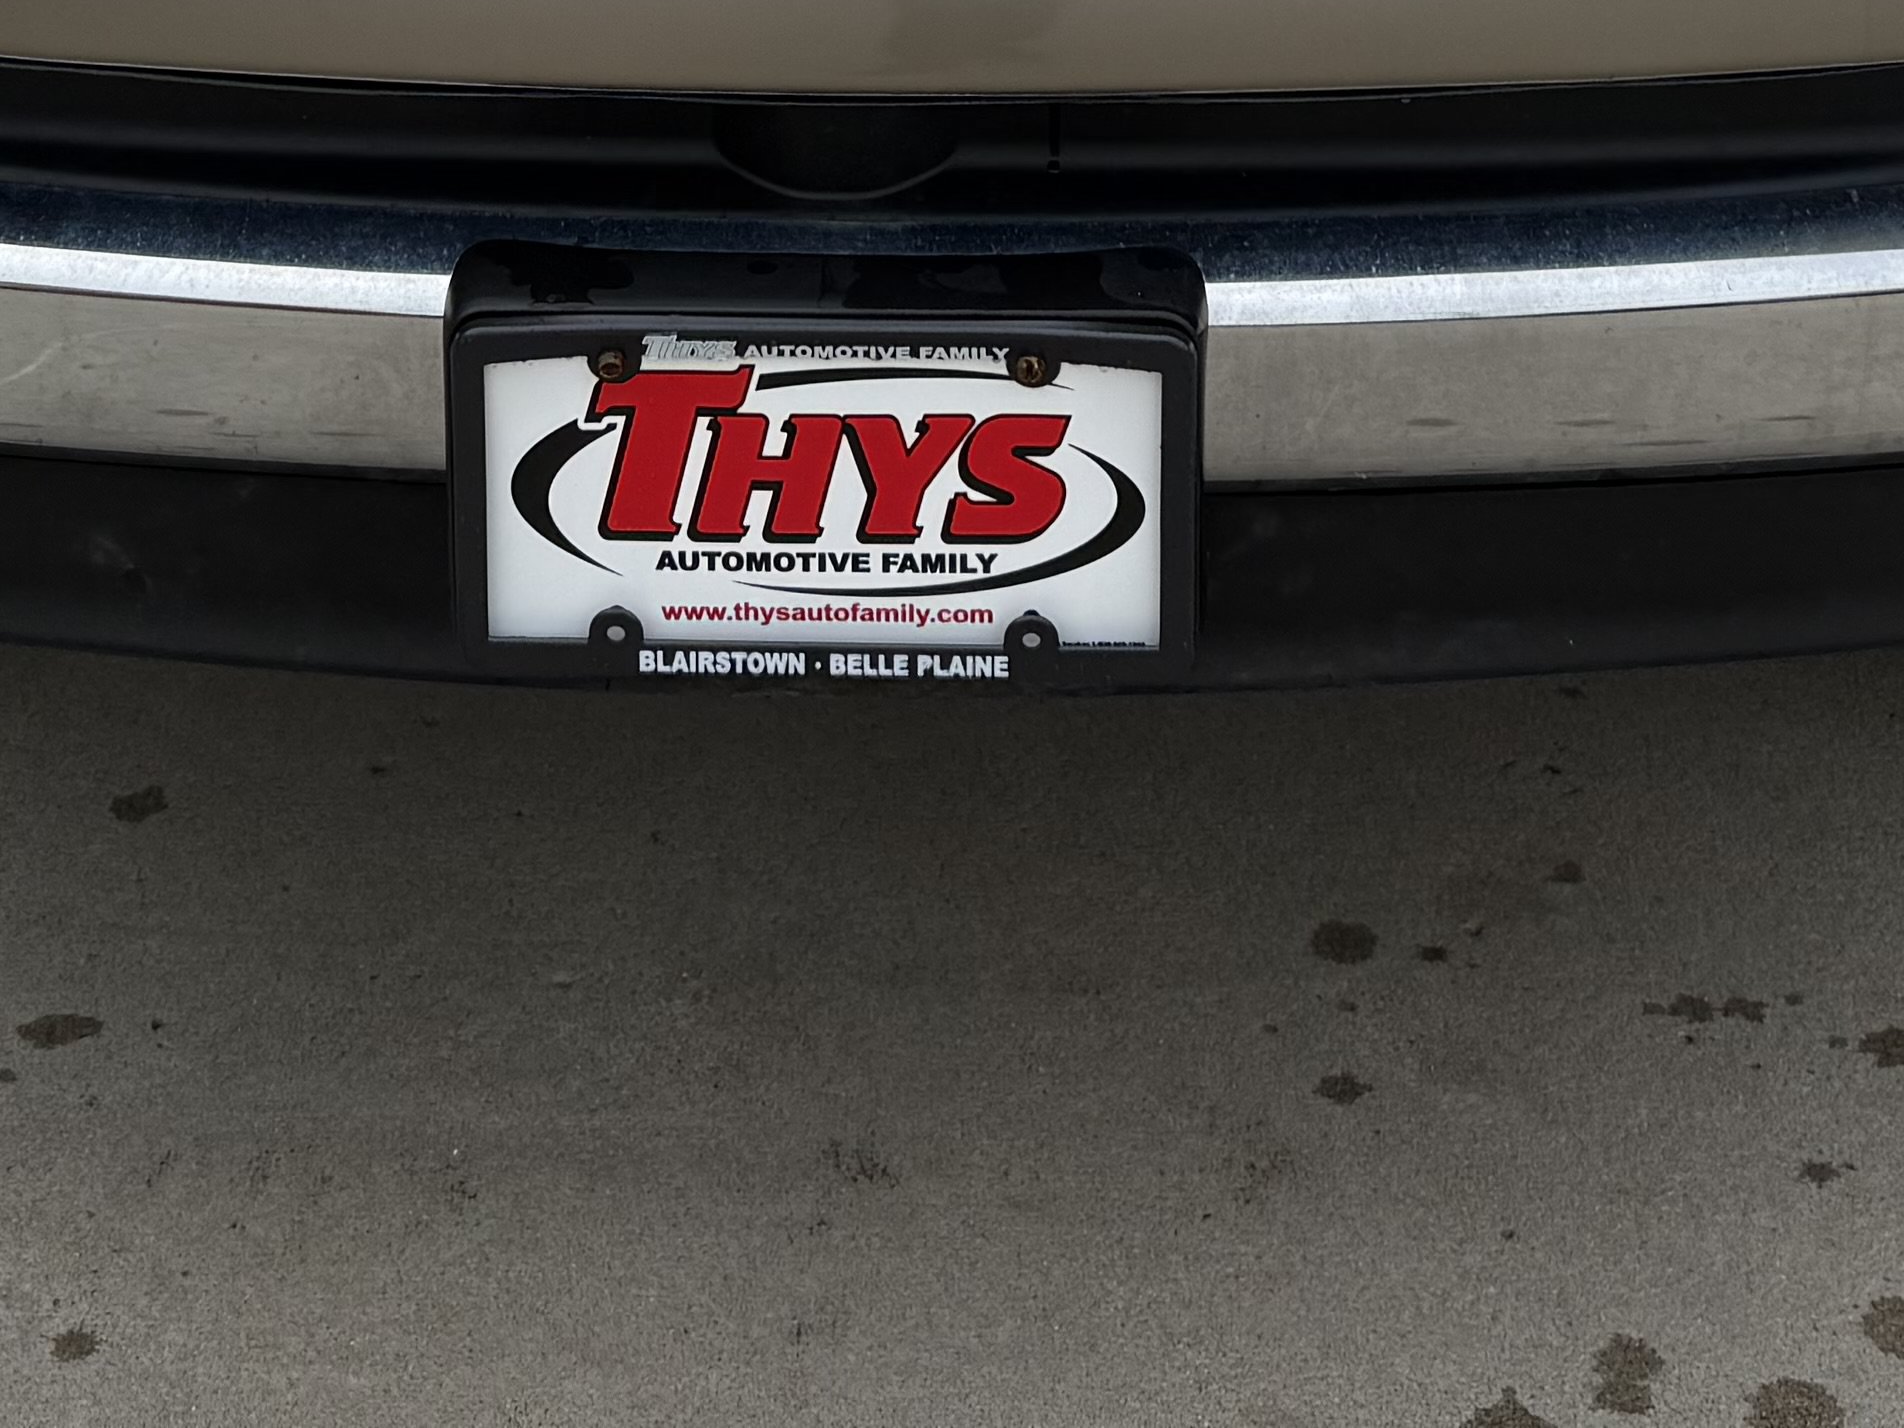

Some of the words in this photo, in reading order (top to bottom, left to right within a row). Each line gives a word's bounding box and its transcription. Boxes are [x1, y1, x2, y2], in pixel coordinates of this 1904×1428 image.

[743, 345, 910, 361] AUTOMOTIVE
[919, 346, 1010, 363] FAMILY
[592, 364, 1073, 544] THYS
[655, 550, 872, 574] AUTOMOTIVE
[881, 552, 999, 575] FAMILY
[661, 602, 994, 628] www.thysautofamily.com
[638, 650, 807, 676] BLAIRSTOWN
[829, 653, 909, 678] BELLE
[916, 655, 1010, 680] PLAINE
